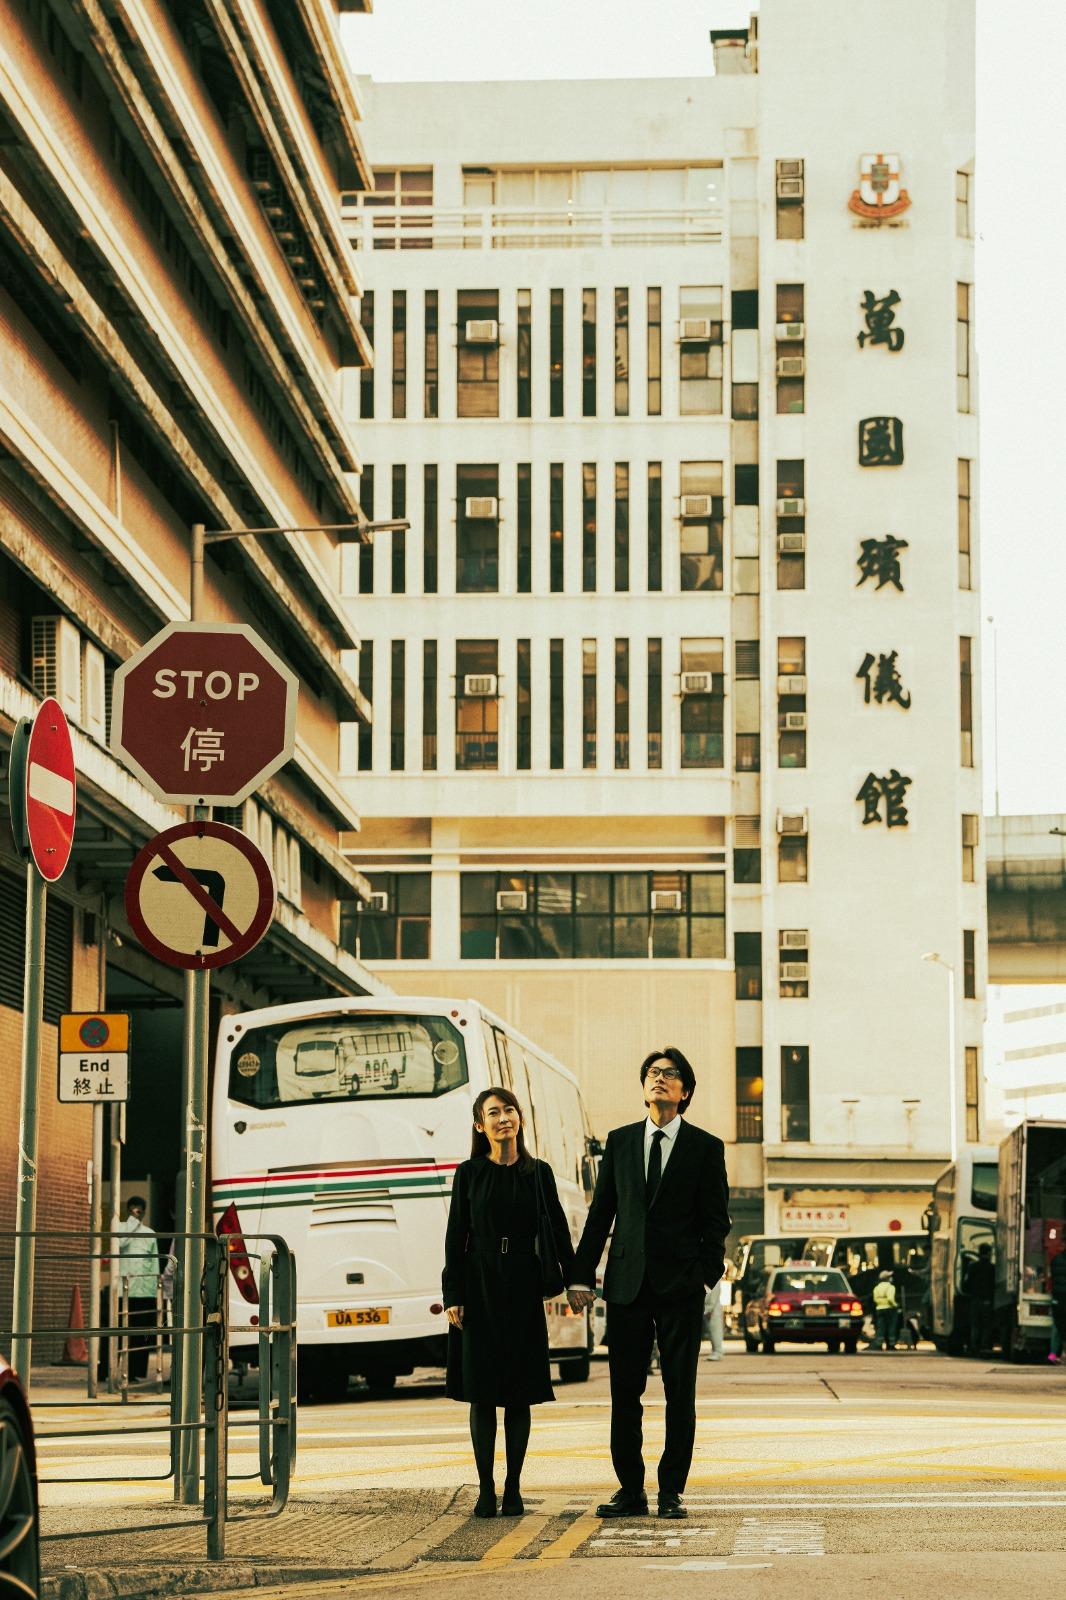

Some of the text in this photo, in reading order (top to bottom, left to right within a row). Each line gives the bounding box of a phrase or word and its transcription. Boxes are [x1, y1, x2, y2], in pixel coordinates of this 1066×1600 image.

[855, 288, 913, 829] 萬國殯儀館
[151, 668, 260, 701] STOP
[180, 726, 225, 772] 停
[79, 1058, 110, 1072] End
[73, 1077, 115, 1096] 終止
[335, 1311, 382, 1325] UA 536
